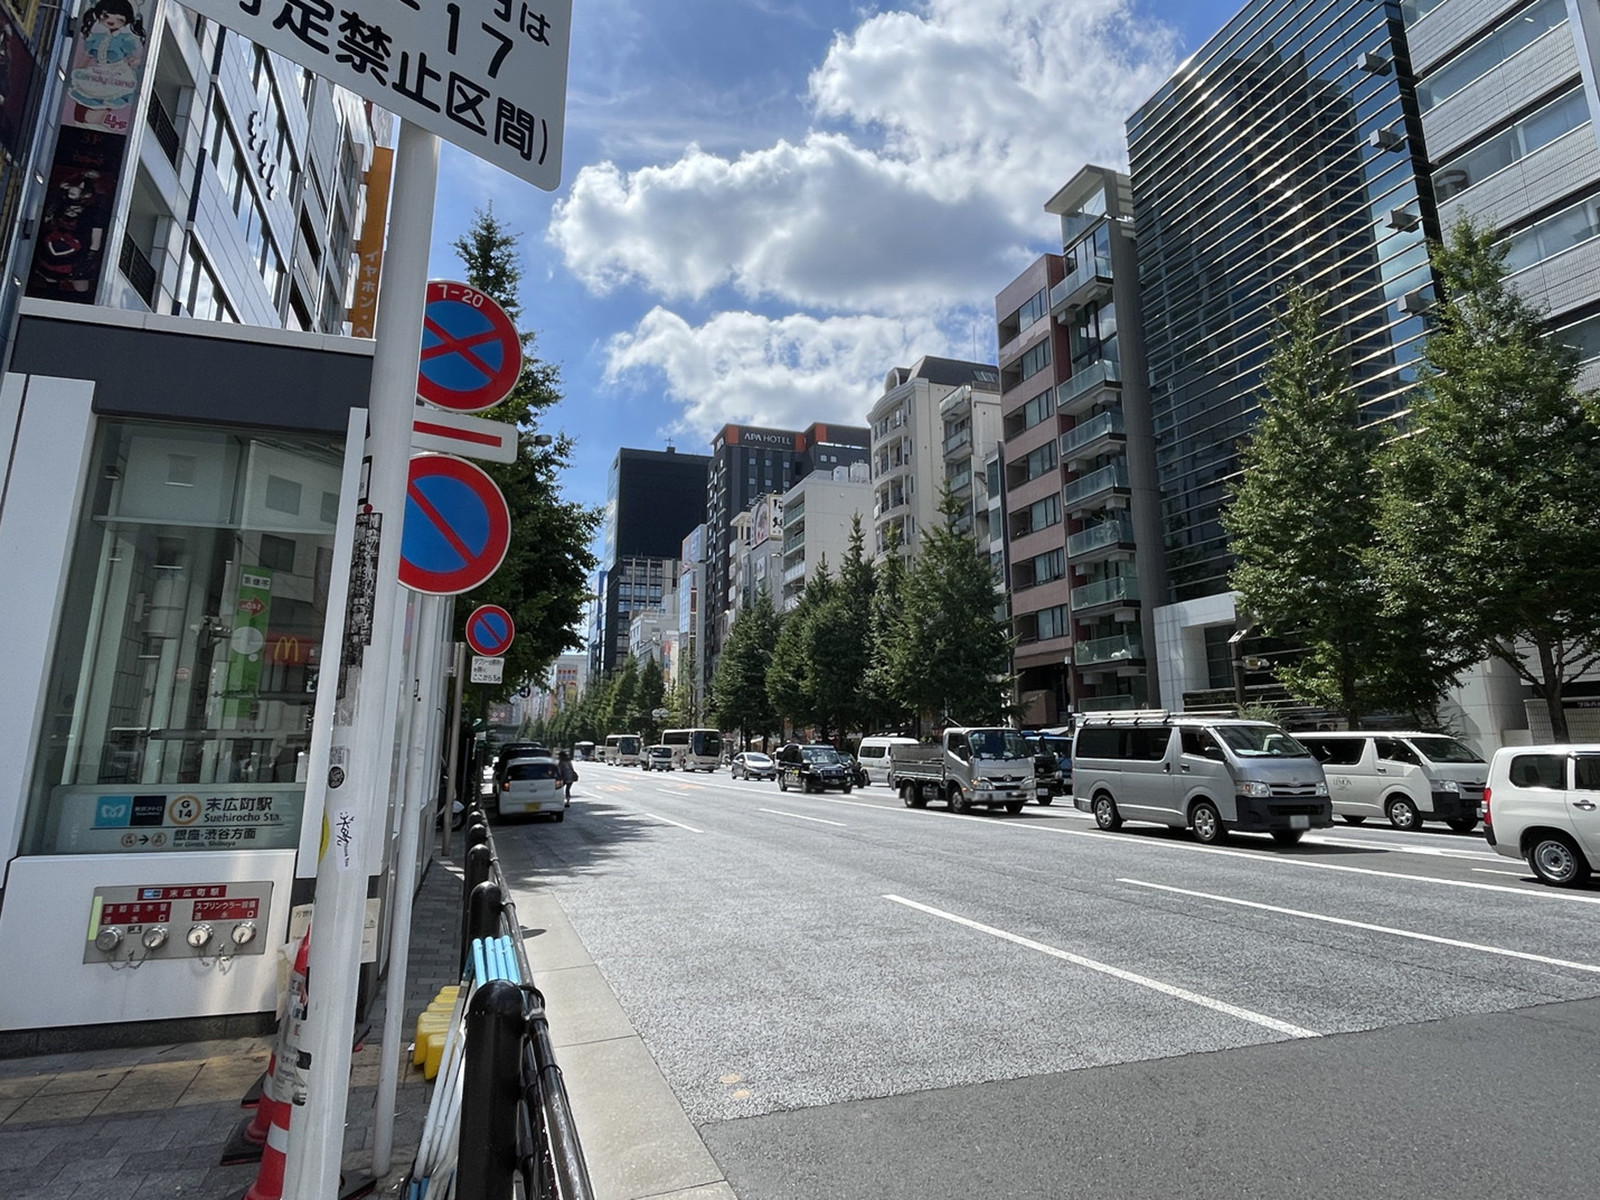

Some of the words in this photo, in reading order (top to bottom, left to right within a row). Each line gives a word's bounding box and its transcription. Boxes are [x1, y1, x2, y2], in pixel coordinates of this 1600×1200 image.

[239, 0, 547, 165] 定禁止区間)
[438, 284, 484, 308] 7-20
[744, 432, 762, 442] APA
[763, 434, 791, 445] HOTEL
[181, 800, 190, 809] G
[205, 797, 272, 811] 末広町駅
[179, 810, 192, 818] 14
[204, 812, 260, 823] Suehirocho
[264, 812, 282, 821] Sta.
[173, 828, 257, 841] 銀座・渋谷方面
